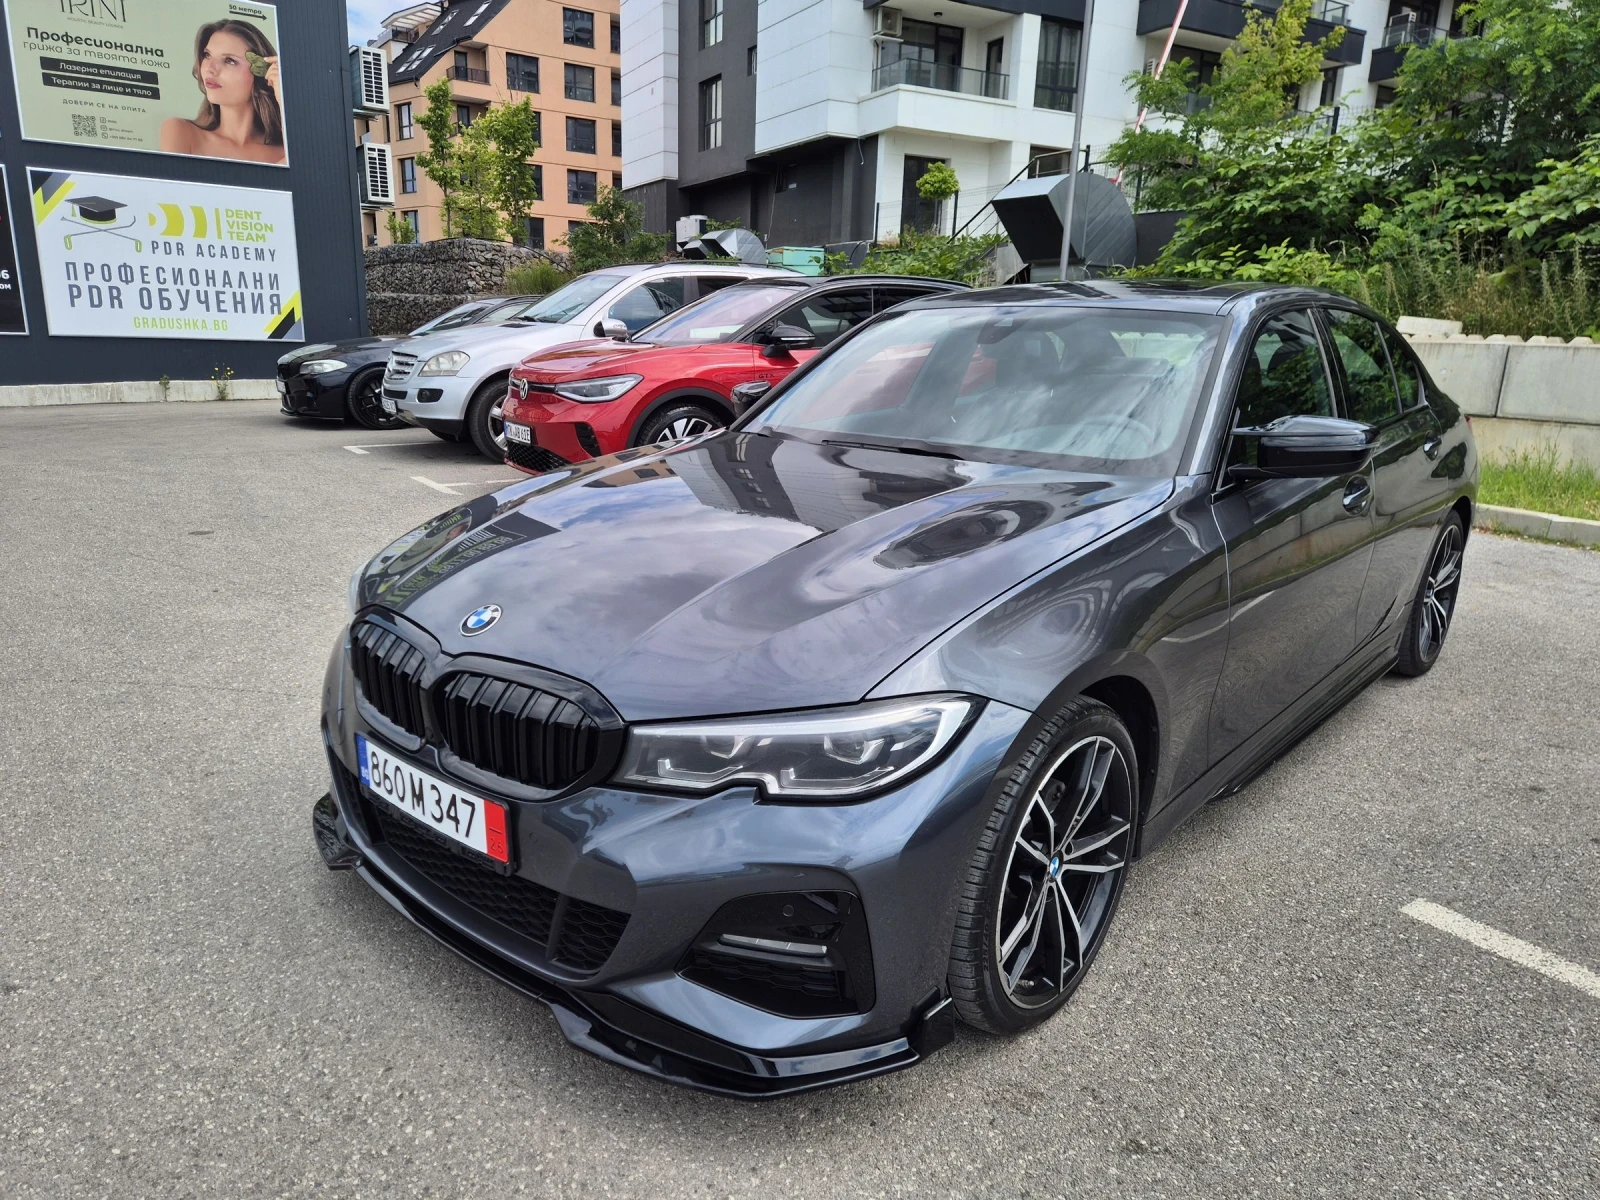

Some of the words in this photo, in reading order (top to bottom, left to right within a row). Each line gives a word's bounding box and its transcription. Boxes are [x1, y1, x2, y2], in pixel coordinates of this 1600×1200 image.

[27, 26, 164, 57] Професионална
[23, 41, 63, 54] грижа
[67, 47, 81, 56] за
[84, 49, 138, 64] твоята
[140, 58, 170, 69] кожа
[60, 62, 98, 74] Лазерна
[99, 69, 142, 80] епилация
[51, 76, 89, 88] Терапии
[102, 84, 124, 92] лице
[132, 88, 152, 96] тяло
[62, 98, 94, 107] ДОВЕРИ
[121, 105, 147, 113] ОПИТА
[225, 208, 263, 221] DENT
[226, 219, 274, 233] VISION
[227, 230, 267, 243] TEAM
[151, 240, 185, 257] PDR
[196, 243, 276, 262] ACADEMY
[65, 261, 280, 291] ПРОФЕСИОНАЛНИ
[68, 283, 124, 309] PDR
[138, 286, 282, 316] ОБУЧЕНИЯ
[133, 316, 229, 331] GRADUSHKA.BG
